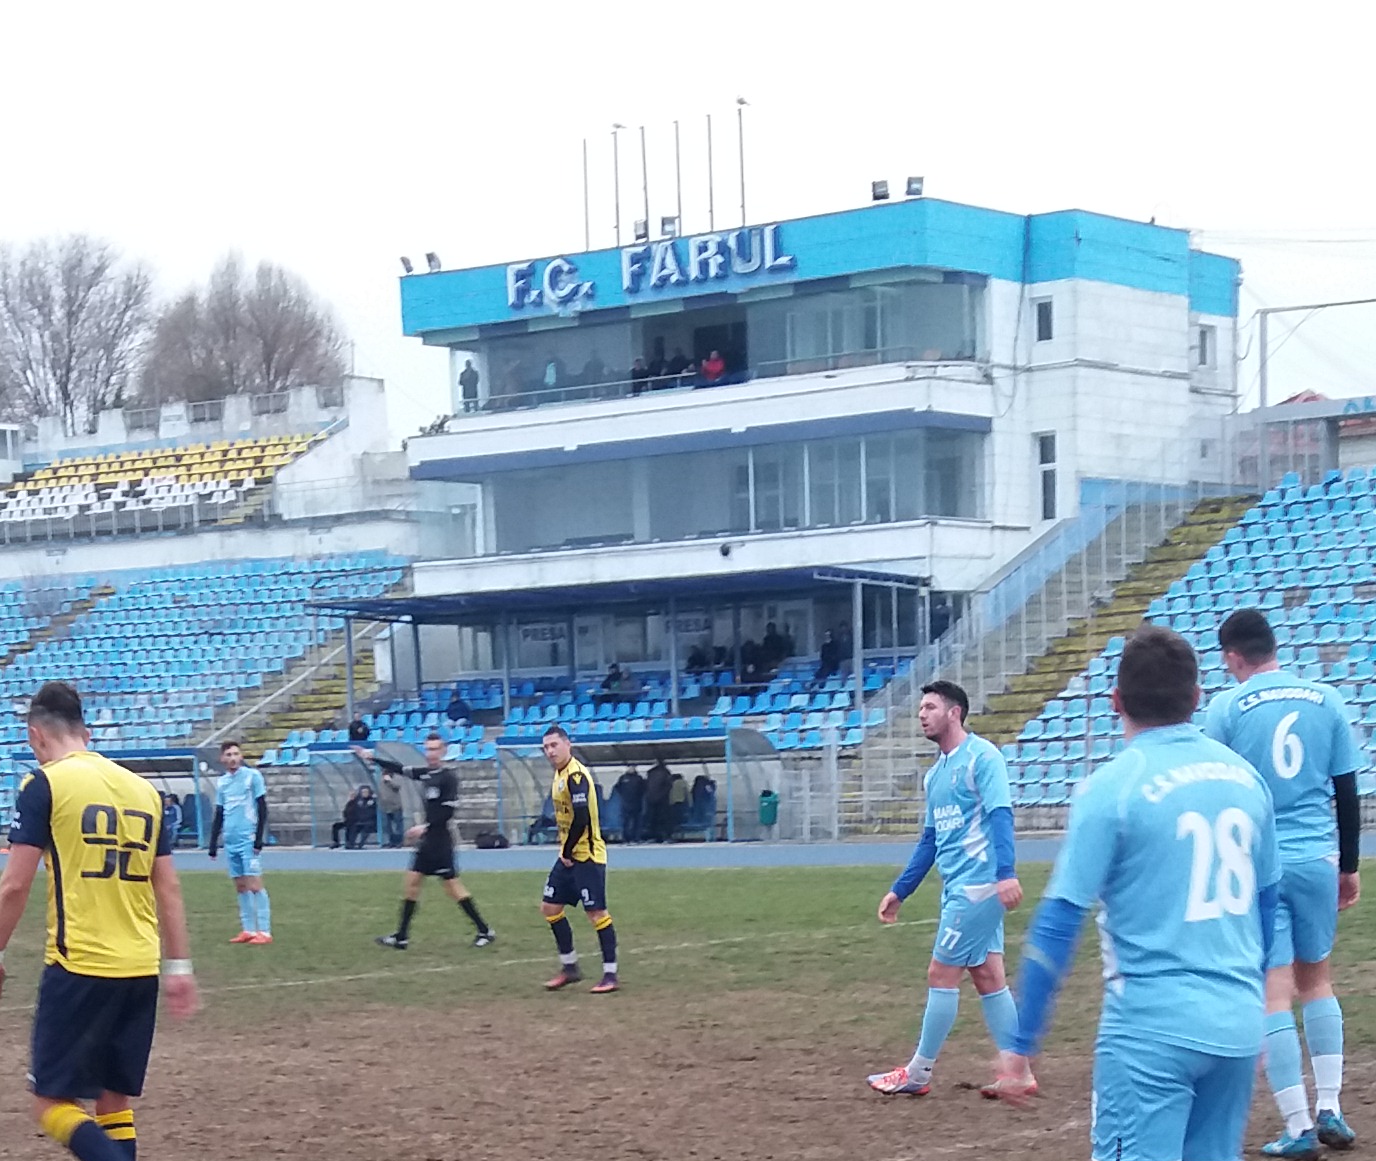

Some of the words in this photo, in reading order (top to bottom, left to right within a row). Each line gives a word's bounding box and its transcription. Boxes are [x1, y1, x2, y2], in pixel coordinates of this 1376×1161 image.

[506, 258, 595, 309] F.C.
[621, 225, 795, 295] FARUL
[1272, 711, 1304, 779] 6
[81, 804, 153, 881] 92
[1176, 808, 1257, 922] 28
[940, 927, 963, 950] 77
